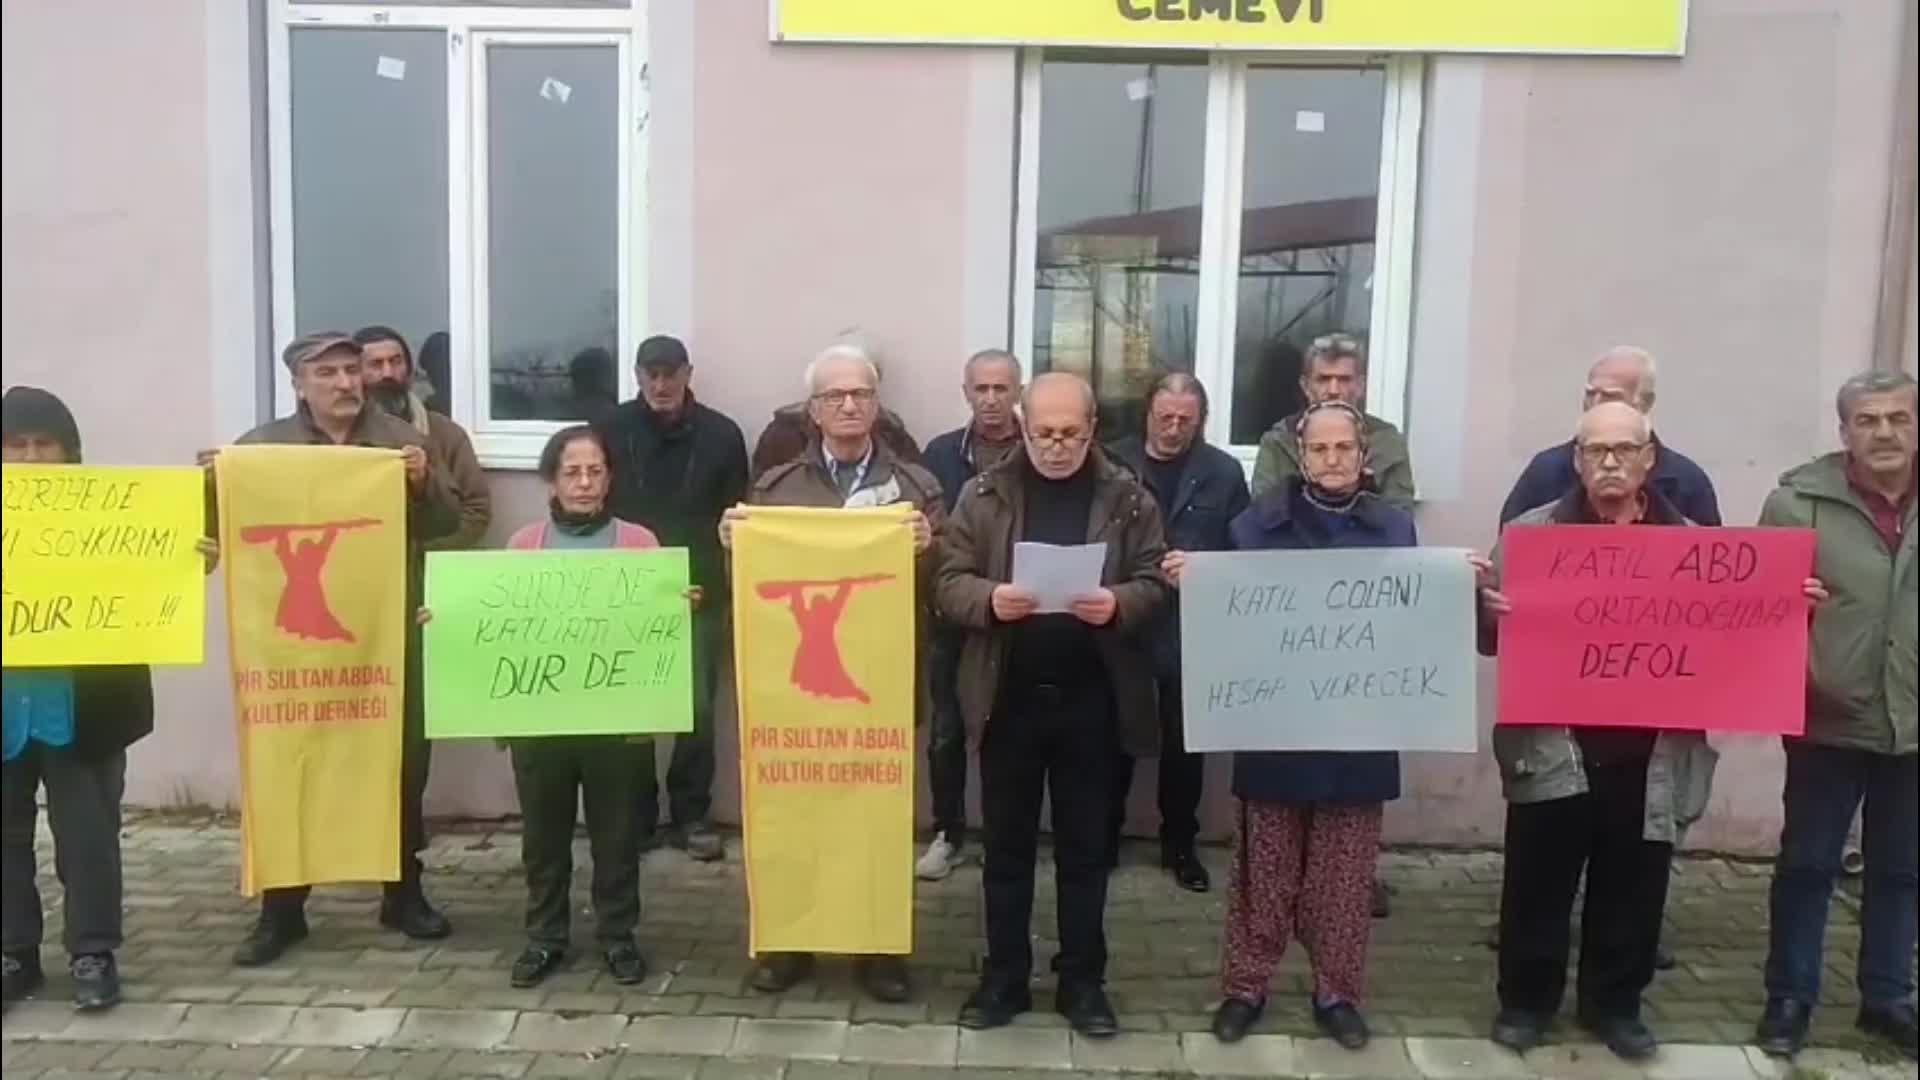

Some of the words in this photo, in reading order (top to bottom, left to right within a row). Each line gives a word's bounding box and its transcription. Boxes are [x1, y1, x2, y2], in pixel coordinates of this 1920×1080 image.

[1672, 541, 1758, 584] ABD
[8, 595, 73, 636] DUR
[625, 614, 682, 645] VAR
[1280, 620, 1376, 652] HALKA
[267, 667, 333, 690] SULTAN
[340, 664, 397, 687] ABDAL
[489, 653, 566, 700] DUR
[1579, 642, 1696, 679] DEFOL
[1207, 676, 1288, 712] HESAP
[1309, 665, 1449, 701] VERECEK
[783, 727, 848, 749] SULTAN
[854, 727, 908, 750] ABDAL
